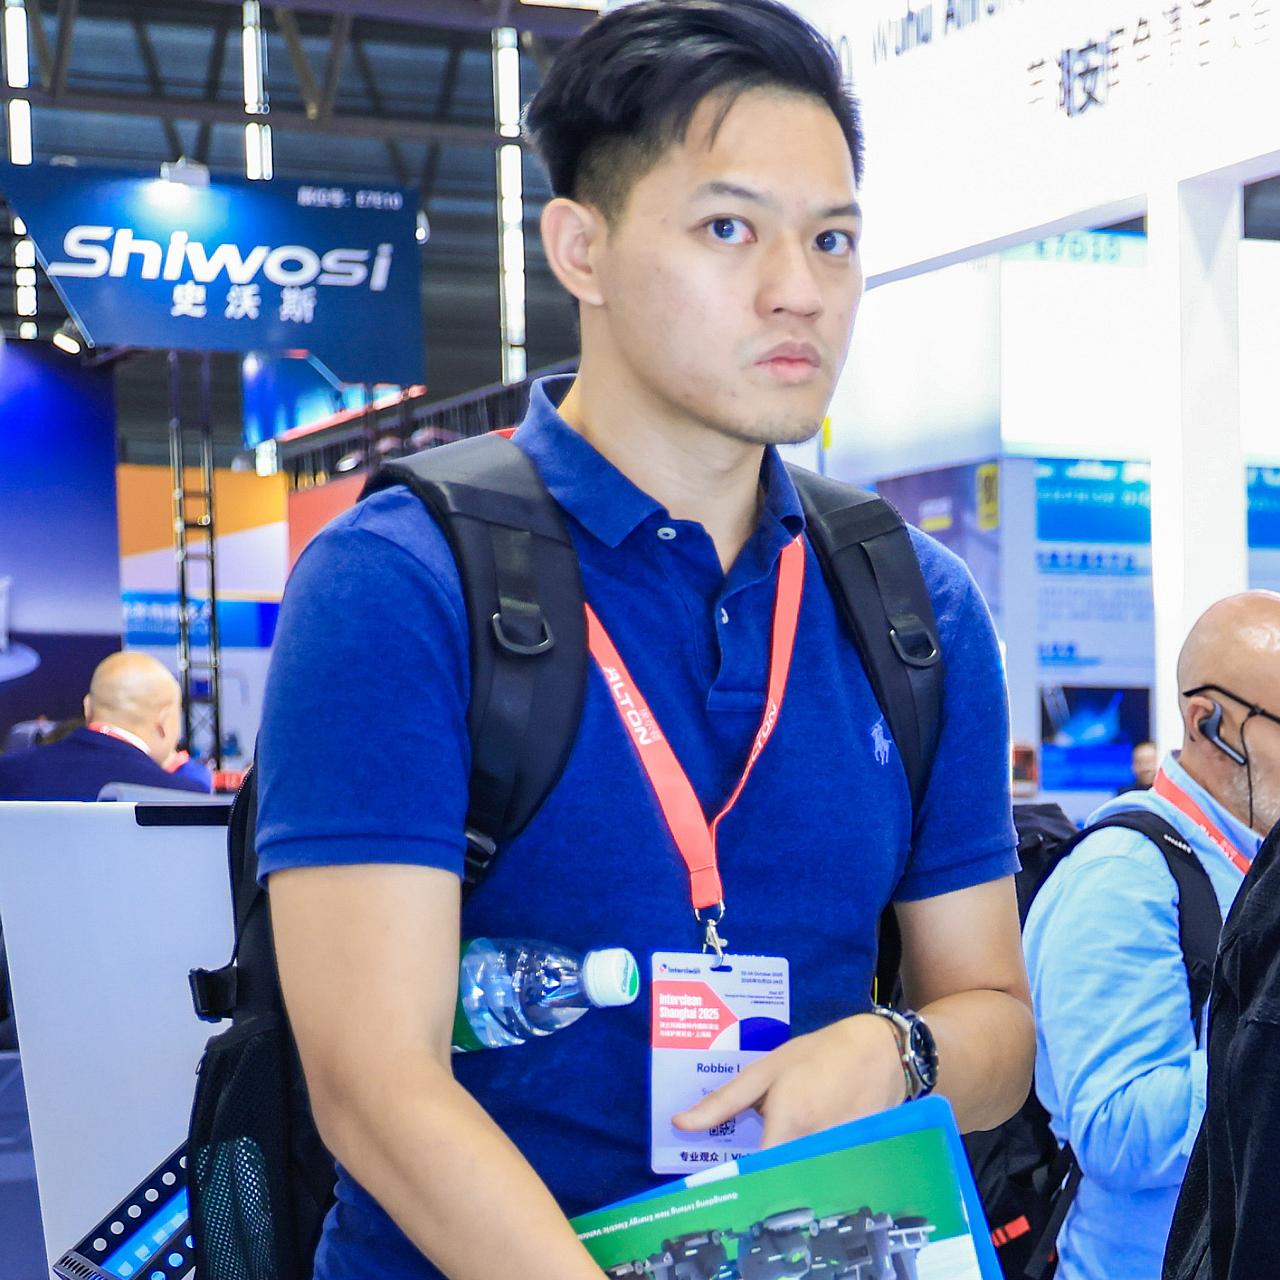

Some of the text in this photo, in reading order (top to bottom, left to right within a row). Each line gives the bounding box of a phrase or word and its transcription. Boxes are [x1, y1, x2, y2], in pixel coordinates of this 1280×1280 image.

[46, 225, 394, 291] Shiwosi
[170, 281, 318, 324] 史沃斯
[602, 666, 652, 745] ALTON
[659, 993, 703, 1006] Interclean
[659, 1006, 720, 1020] Shanghai 2025
[696, 1062, 734, 1074] Robbie
[680, 1151, 719, 1162] 专业观众
[628, 1213, 653, 1226] Energy
